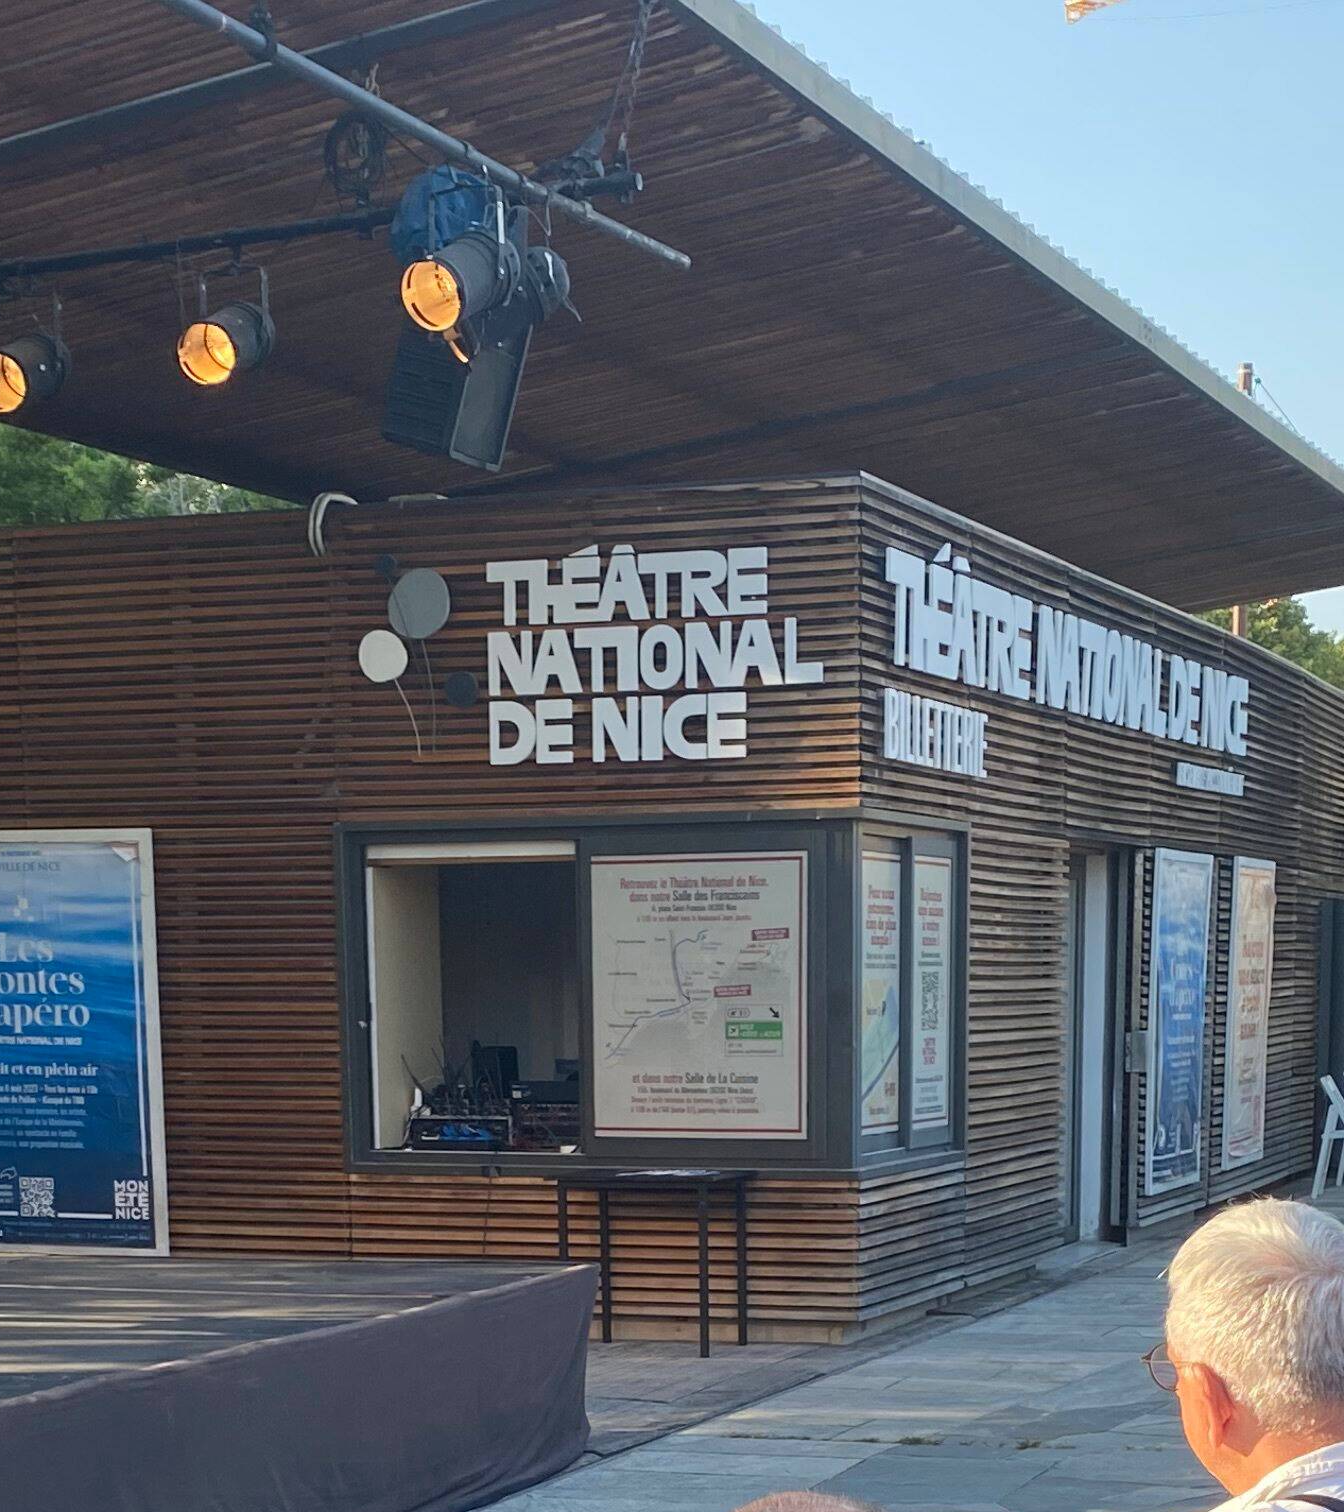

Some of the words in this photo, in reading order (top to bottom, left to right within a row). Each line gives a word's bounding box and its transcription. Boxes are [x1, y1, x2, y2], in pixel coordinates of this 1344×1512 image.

[486, 544, 768, 626] THÉÂTRE
[487, 617, 824, 696] NATIONAL
[885, 542, 1033, 700] THÉÂTRE
[1035, 604, 1169, 738] NATIONAL
[1167, 653, 1202, 745] DE
[1200, 666, 1249, 757] NICE
[489, 699, 574, 765] DE
[592, 691, 747, 762] NICE
[883, 688, 988, 778] BILLETTERIE
[672, 890, 692, 902] Salle
[694, 890, 708, 901] des
[0, 932, 53, 962] Les
[11, 1064, 24, 1075] et
[26, 1065, 42, 1076] en
[44, 1062, 76, 1078] plein
[80, 1063, 99, 1077] air
[685, 1072, 704, 1084] Salle
[706, 1073, 717, 1084] de
[718, 1073, 727, 1084] La
[114, 1180, 148, 1191] MON
[115, 1207, 150, 1220] NICE
